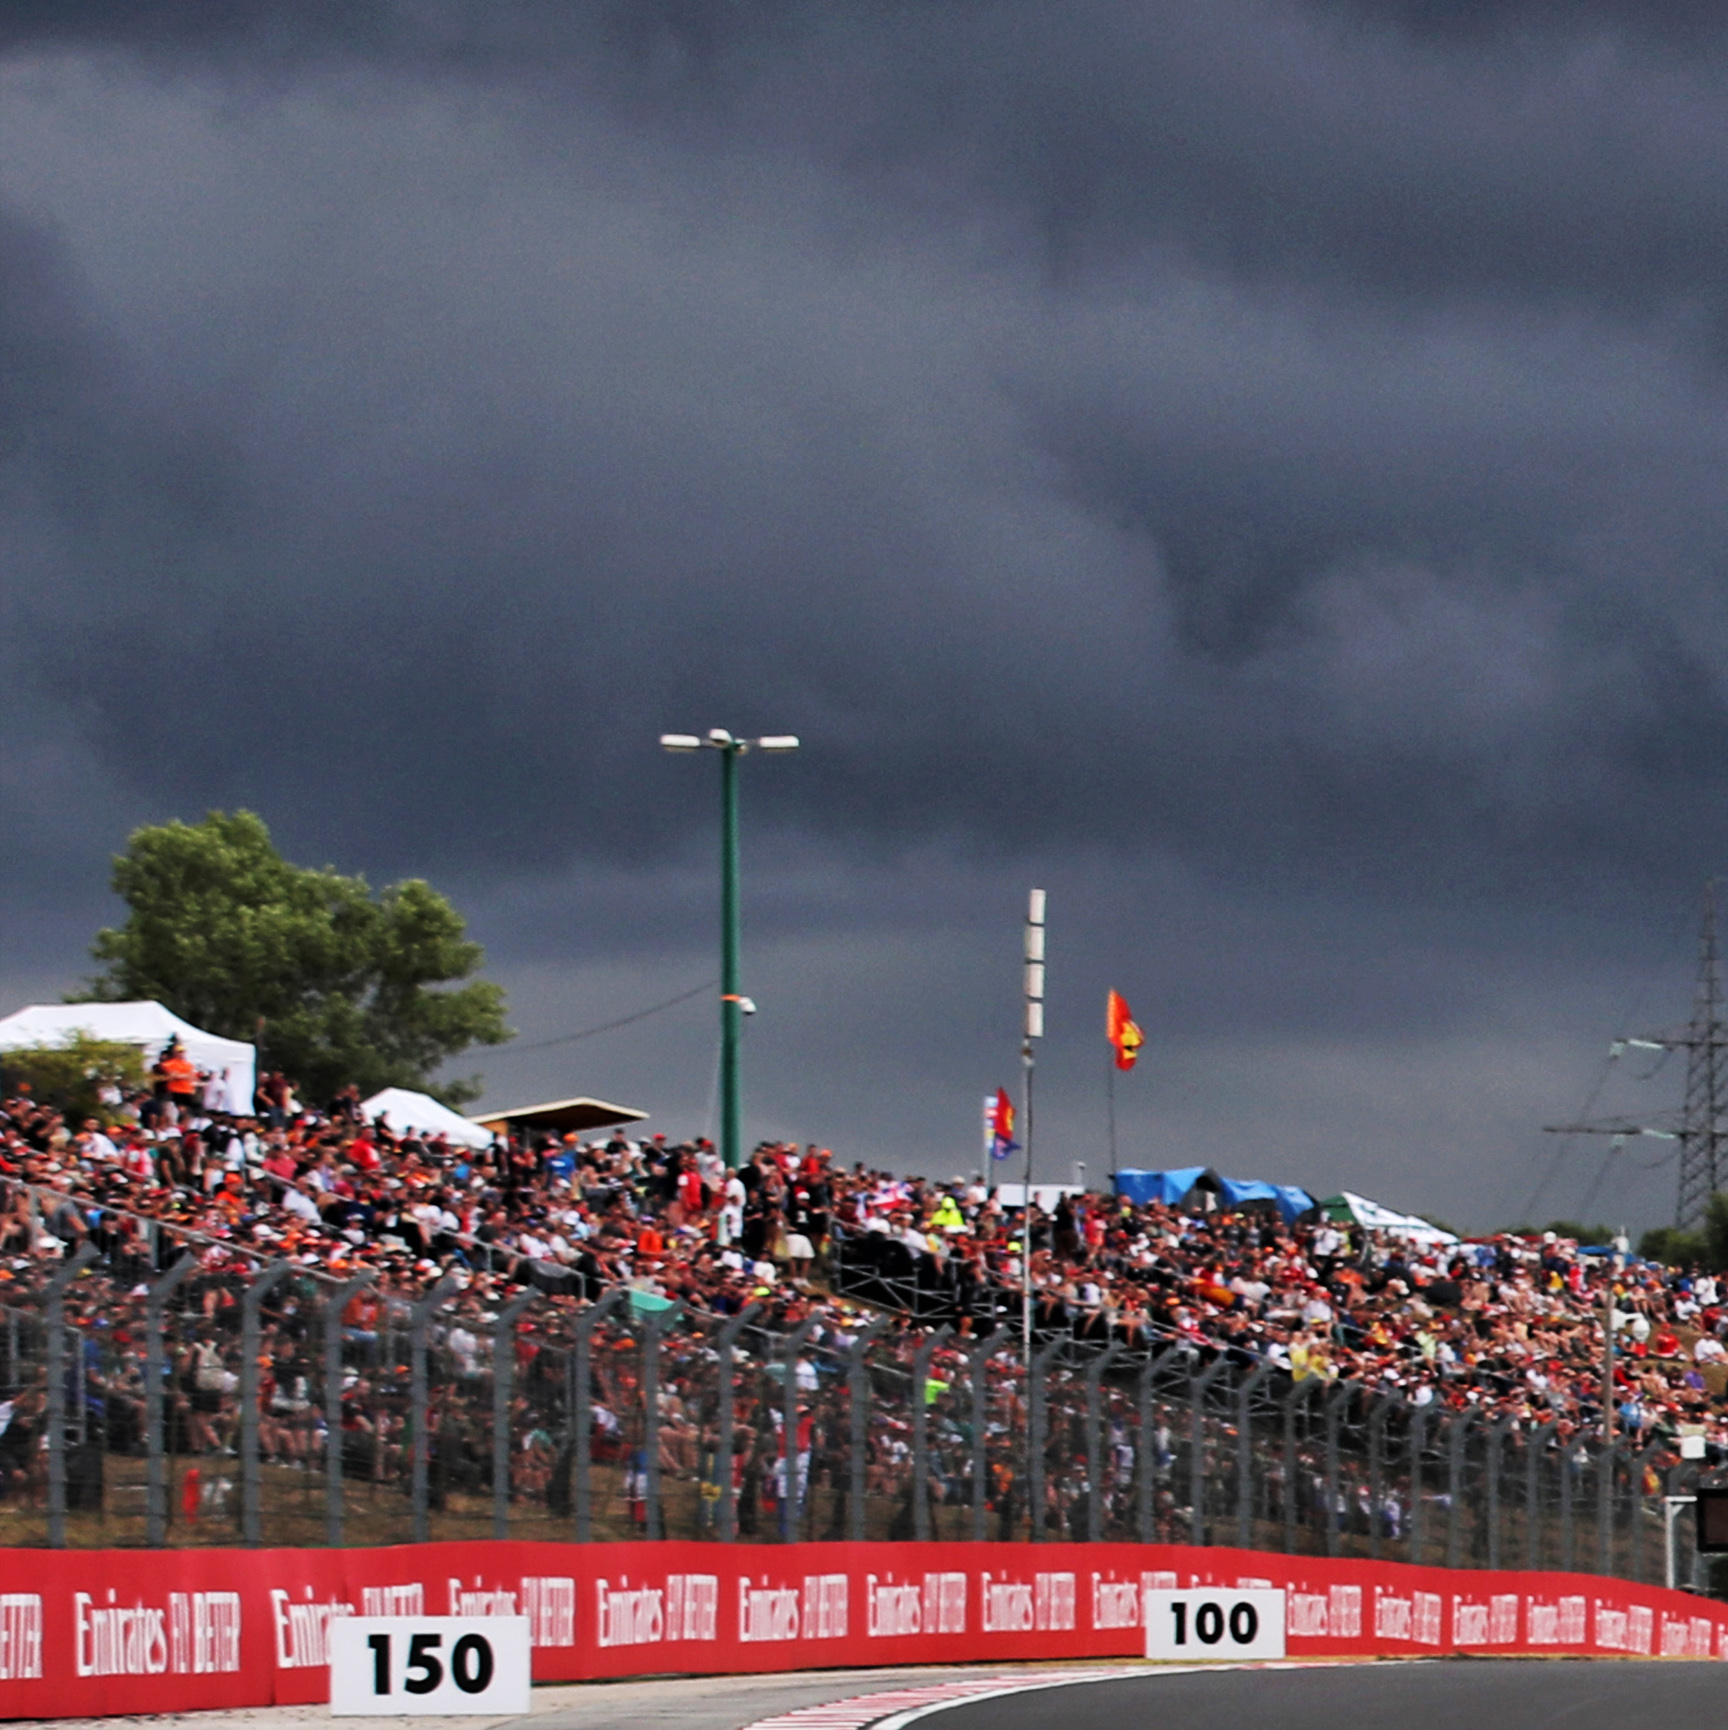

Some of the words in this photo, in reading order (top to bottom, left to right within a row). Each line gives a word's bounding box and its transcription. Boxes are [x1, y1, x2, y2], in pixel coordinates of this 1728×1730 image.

[75, 1588, 168, 1677] Emirates
[1171, 1601, 1258, 1645] 100
[368, 1633, 493, 1695] 150
